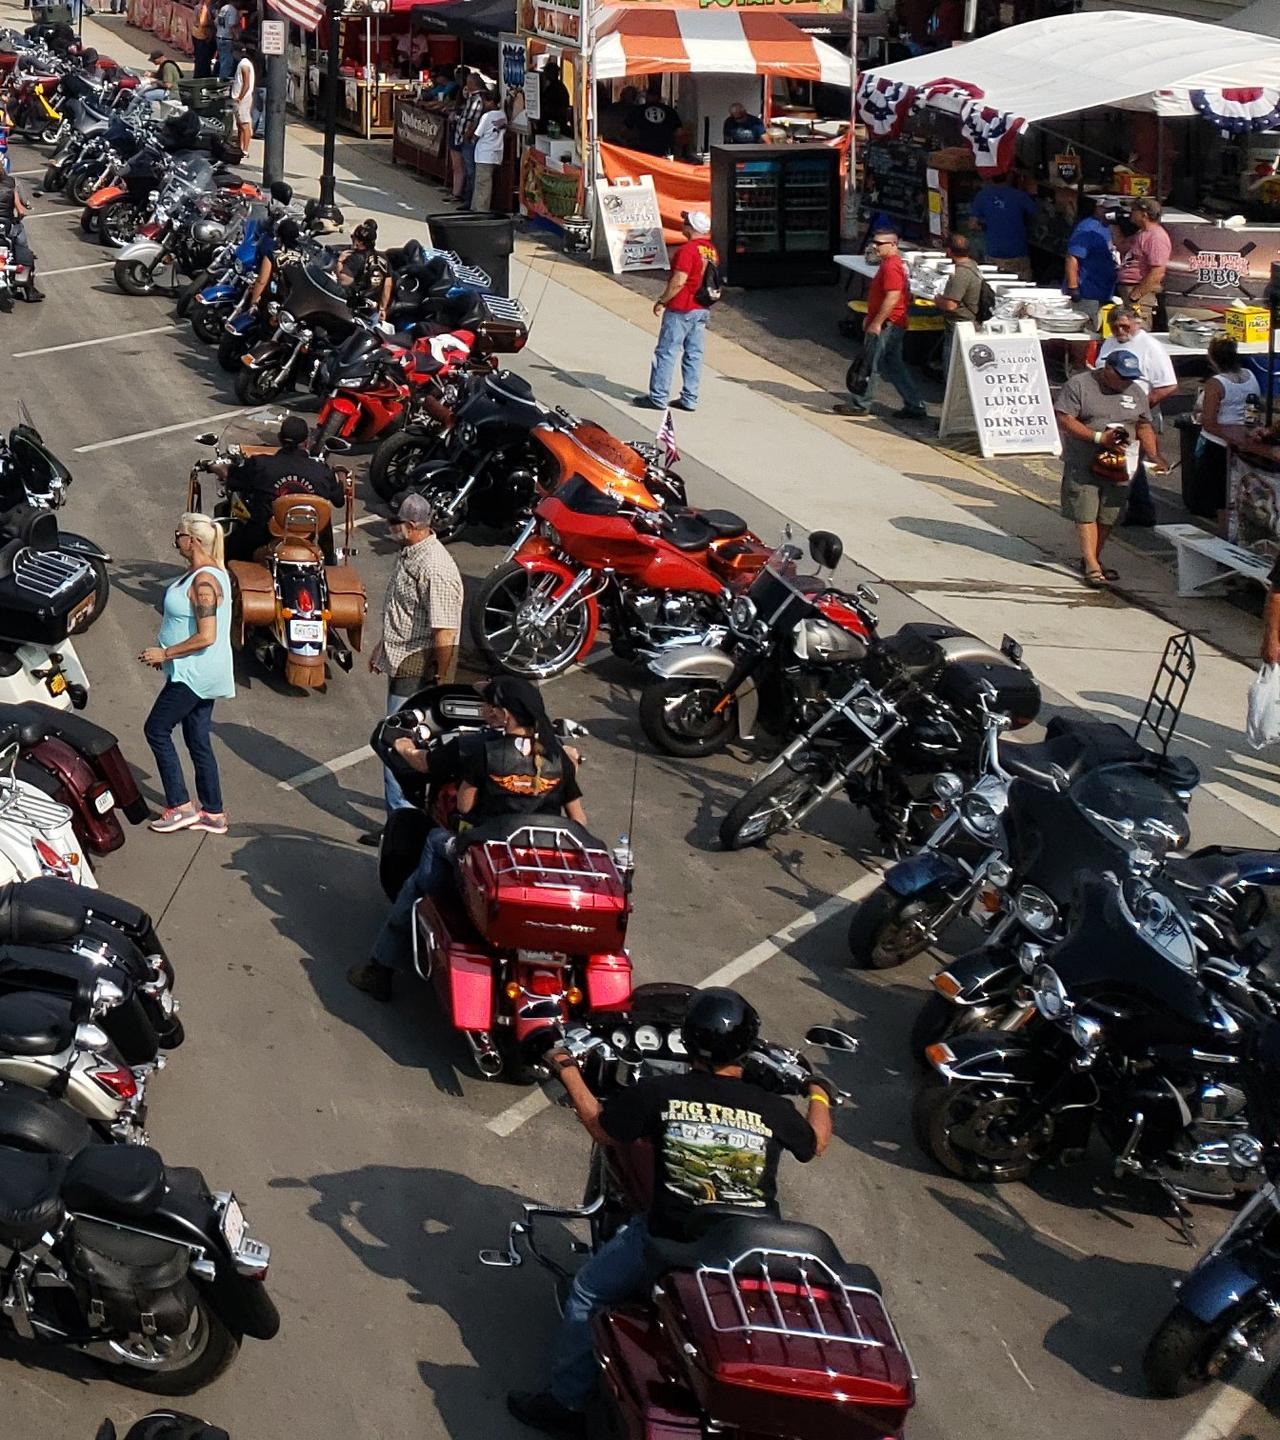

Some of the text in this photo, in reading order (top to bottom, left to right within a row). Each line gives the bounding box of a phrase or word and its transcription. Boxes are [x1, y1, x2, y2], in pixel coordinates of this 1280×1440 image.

[1198, 269, 1240, 286] BBQ
[984, 373, 1029, 385] OPEN
[984, 394, 1041, 406] LUNCH
[983, 415, 1049, 427] DINNER
[668, 1099, 765, 1126] PIG TRAIL
[661, 1111, 774, 1138] HARLEY-DAVIDSON
